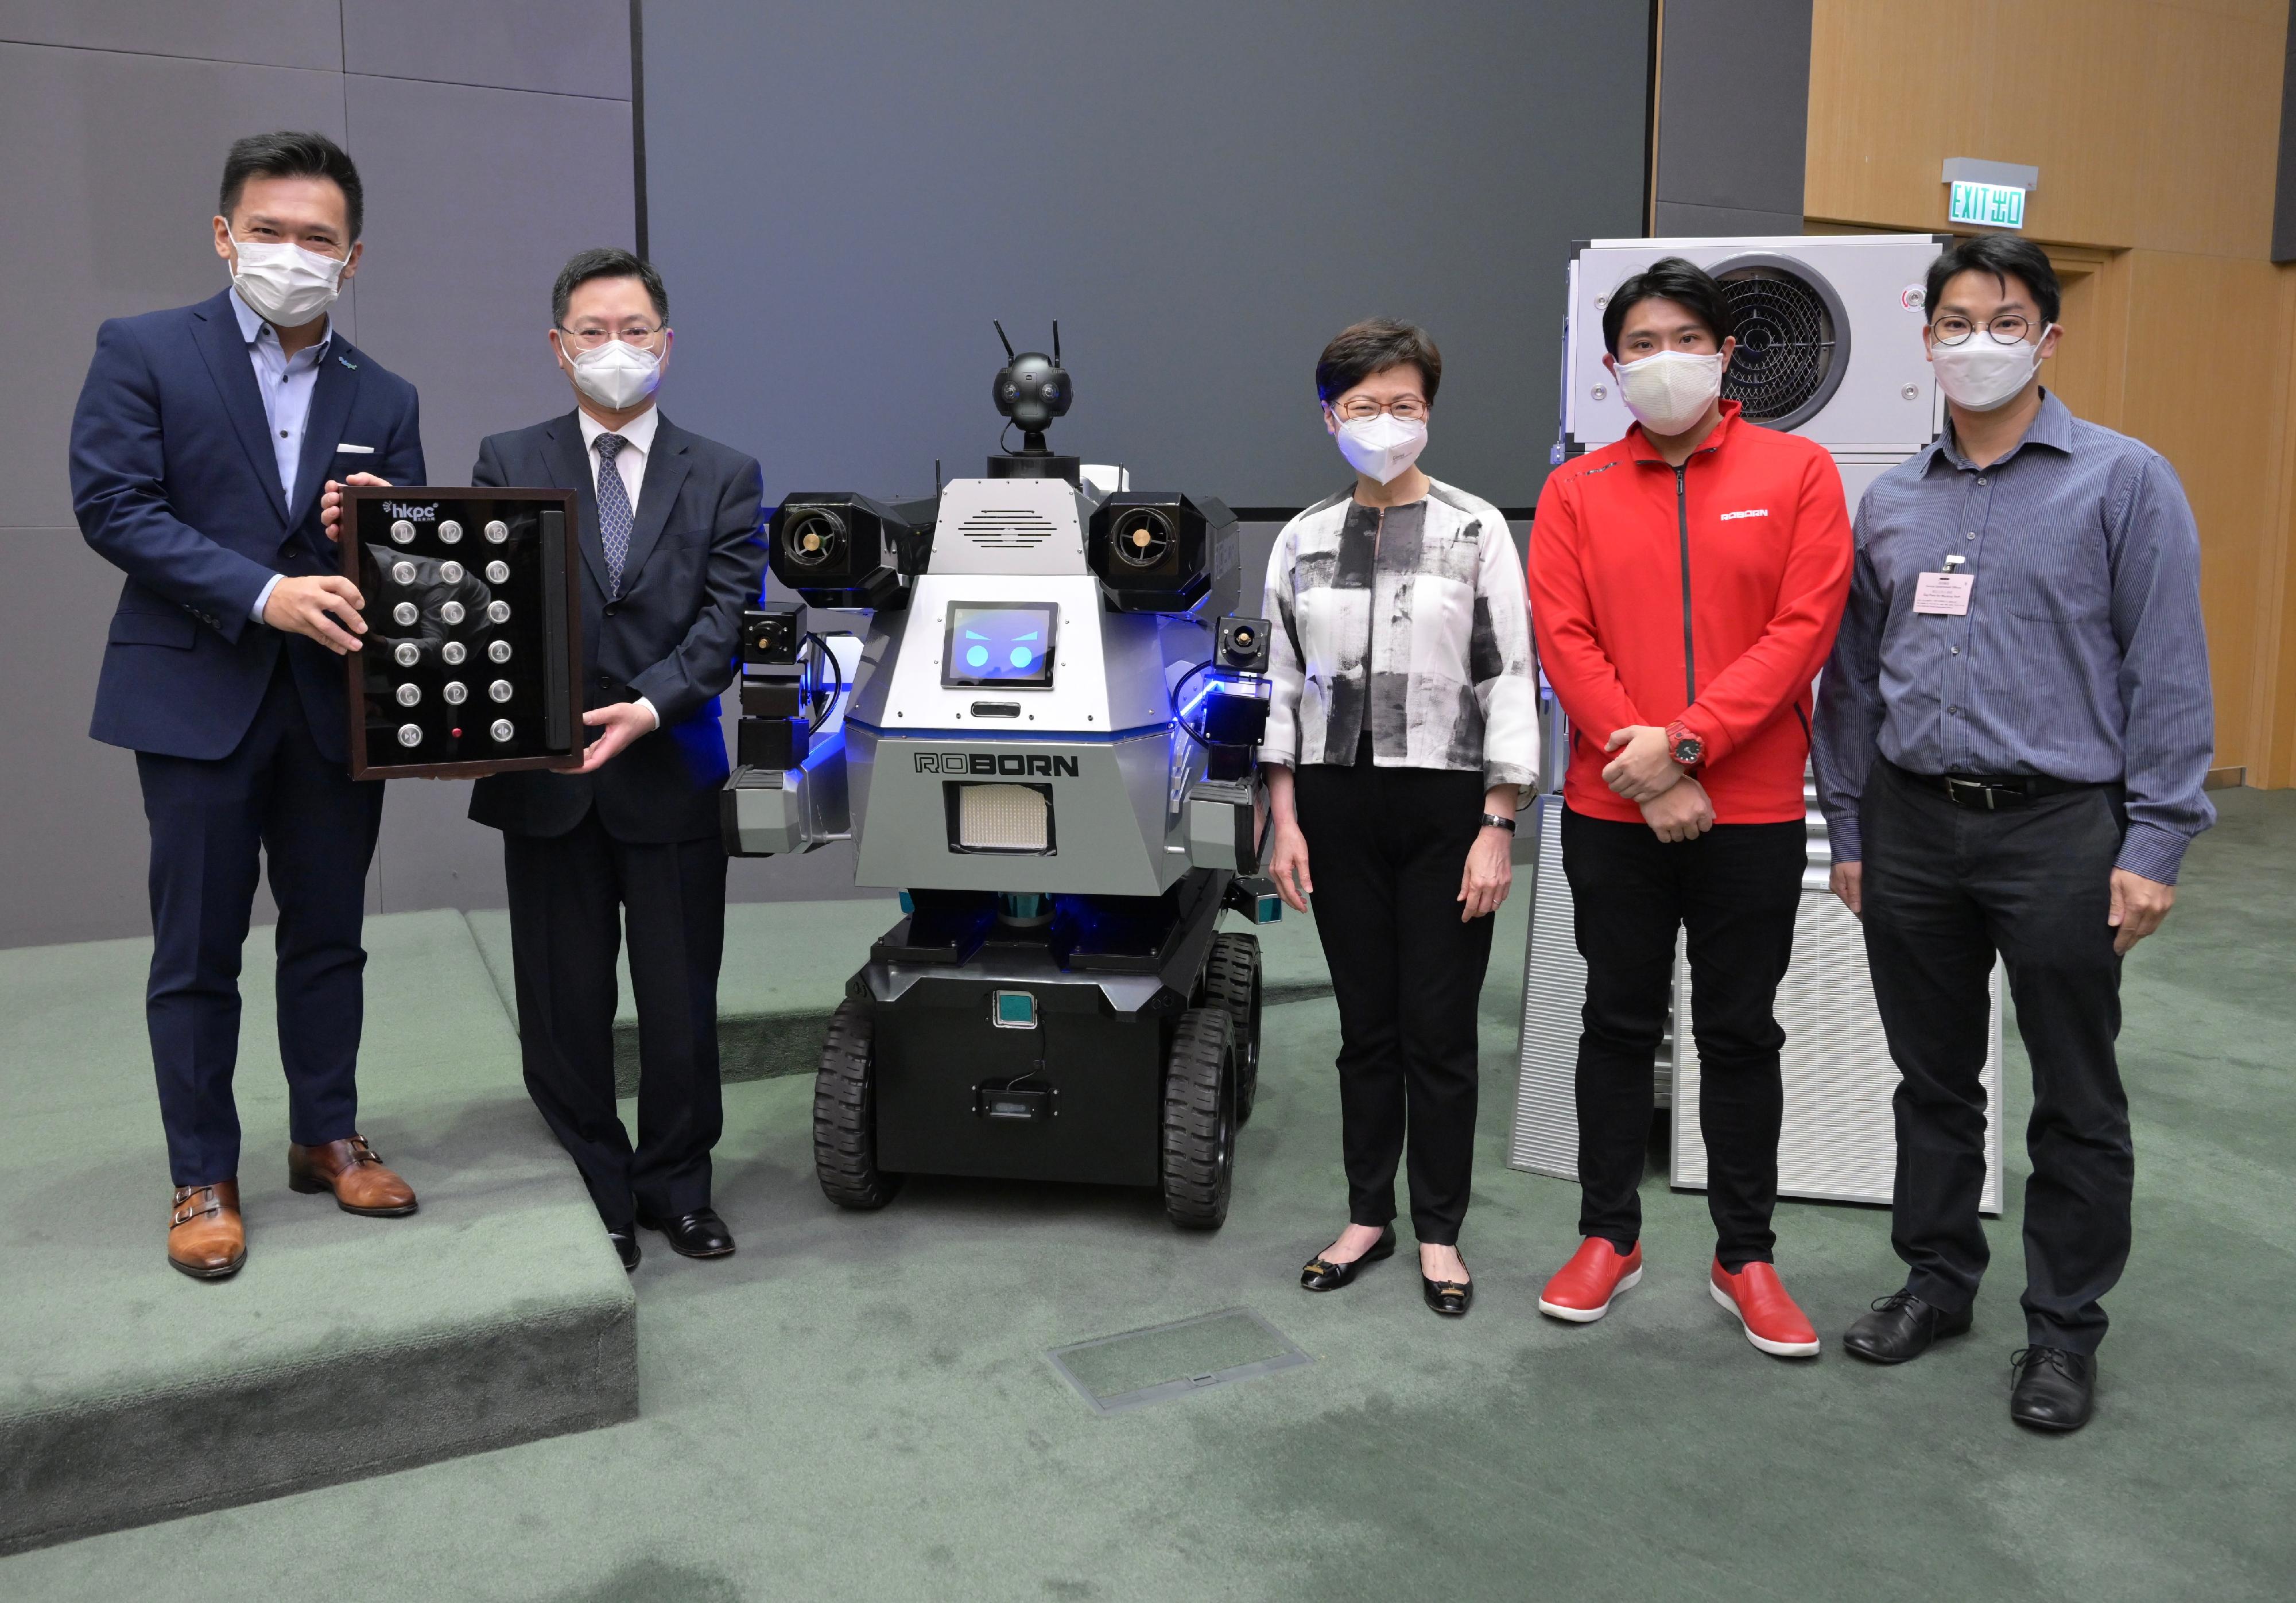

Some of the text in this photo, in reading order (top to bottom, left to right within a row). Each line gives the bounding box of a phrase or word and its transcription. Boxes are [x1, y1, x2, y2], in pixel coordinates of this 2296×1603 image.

[1952, 184, 2022, 224] EXIT 出口
[393, 503, 435, 521] hkpc
[1721, 509, 1768, 521] ROBORN
[445, 527, 457, 538] 12
[492, 527, 503, 538] 13
[402, 568, 408, 580] 8
[448, 568, 455, 579] 9
[492, 567, 504, 579] 10
[403, 609, 410, 620] 5
[450, 607, 457, 619] 6
[404, 650, 412, 662] 2
[452, 649, 459, 660] 3
[496, 647, 503, 658] 4
[405, 690, 413, 702] G
[453, 689, 460, 700] P
[914, 752, 1079, 777] ROBORN
